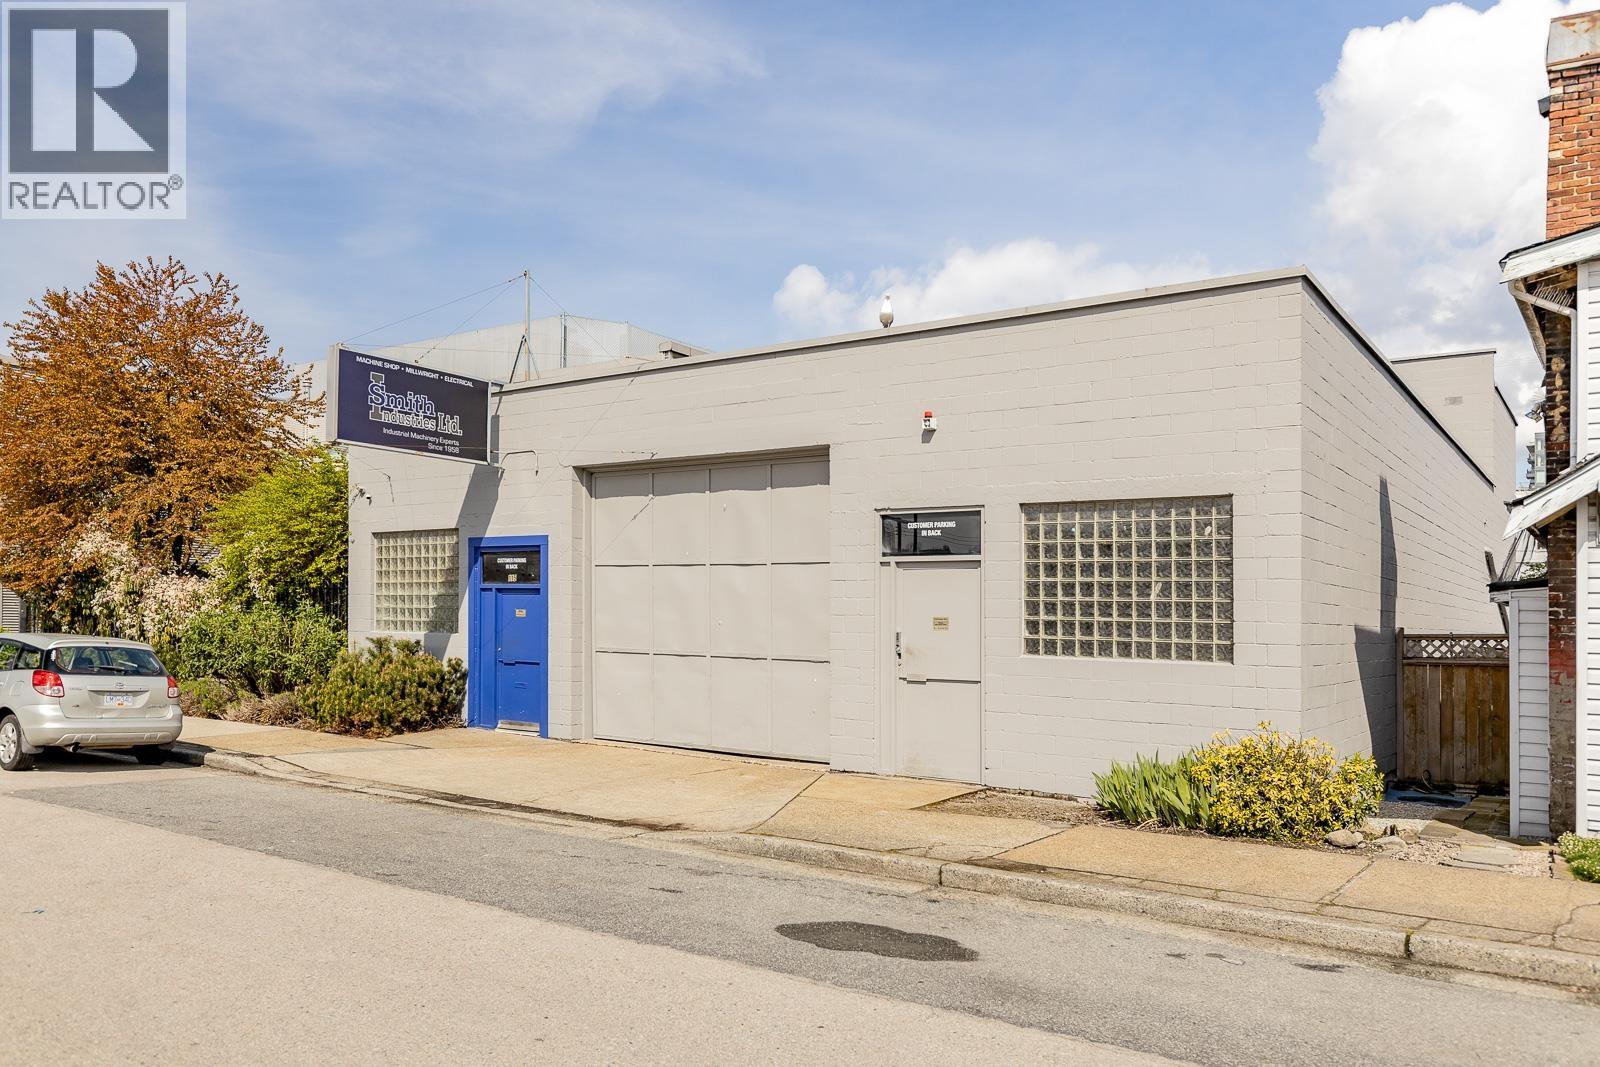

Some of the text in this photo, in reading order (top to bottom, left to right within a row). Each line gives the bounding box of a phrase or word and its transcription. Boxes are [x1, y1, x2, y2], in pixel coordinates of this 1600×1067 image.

[356, 356, 474, 388] MACHINE SHOP MILLWRIGHT ELECTRICAL
[368, 383, 436, 417] Smith
[437, 412, 463, 436] Ltd.
[383, 427, 460, 446] Industrial Machinery Experts
[427, 443, 460, 454] Since 1958
[933, 520, 956, 528] PARKING
